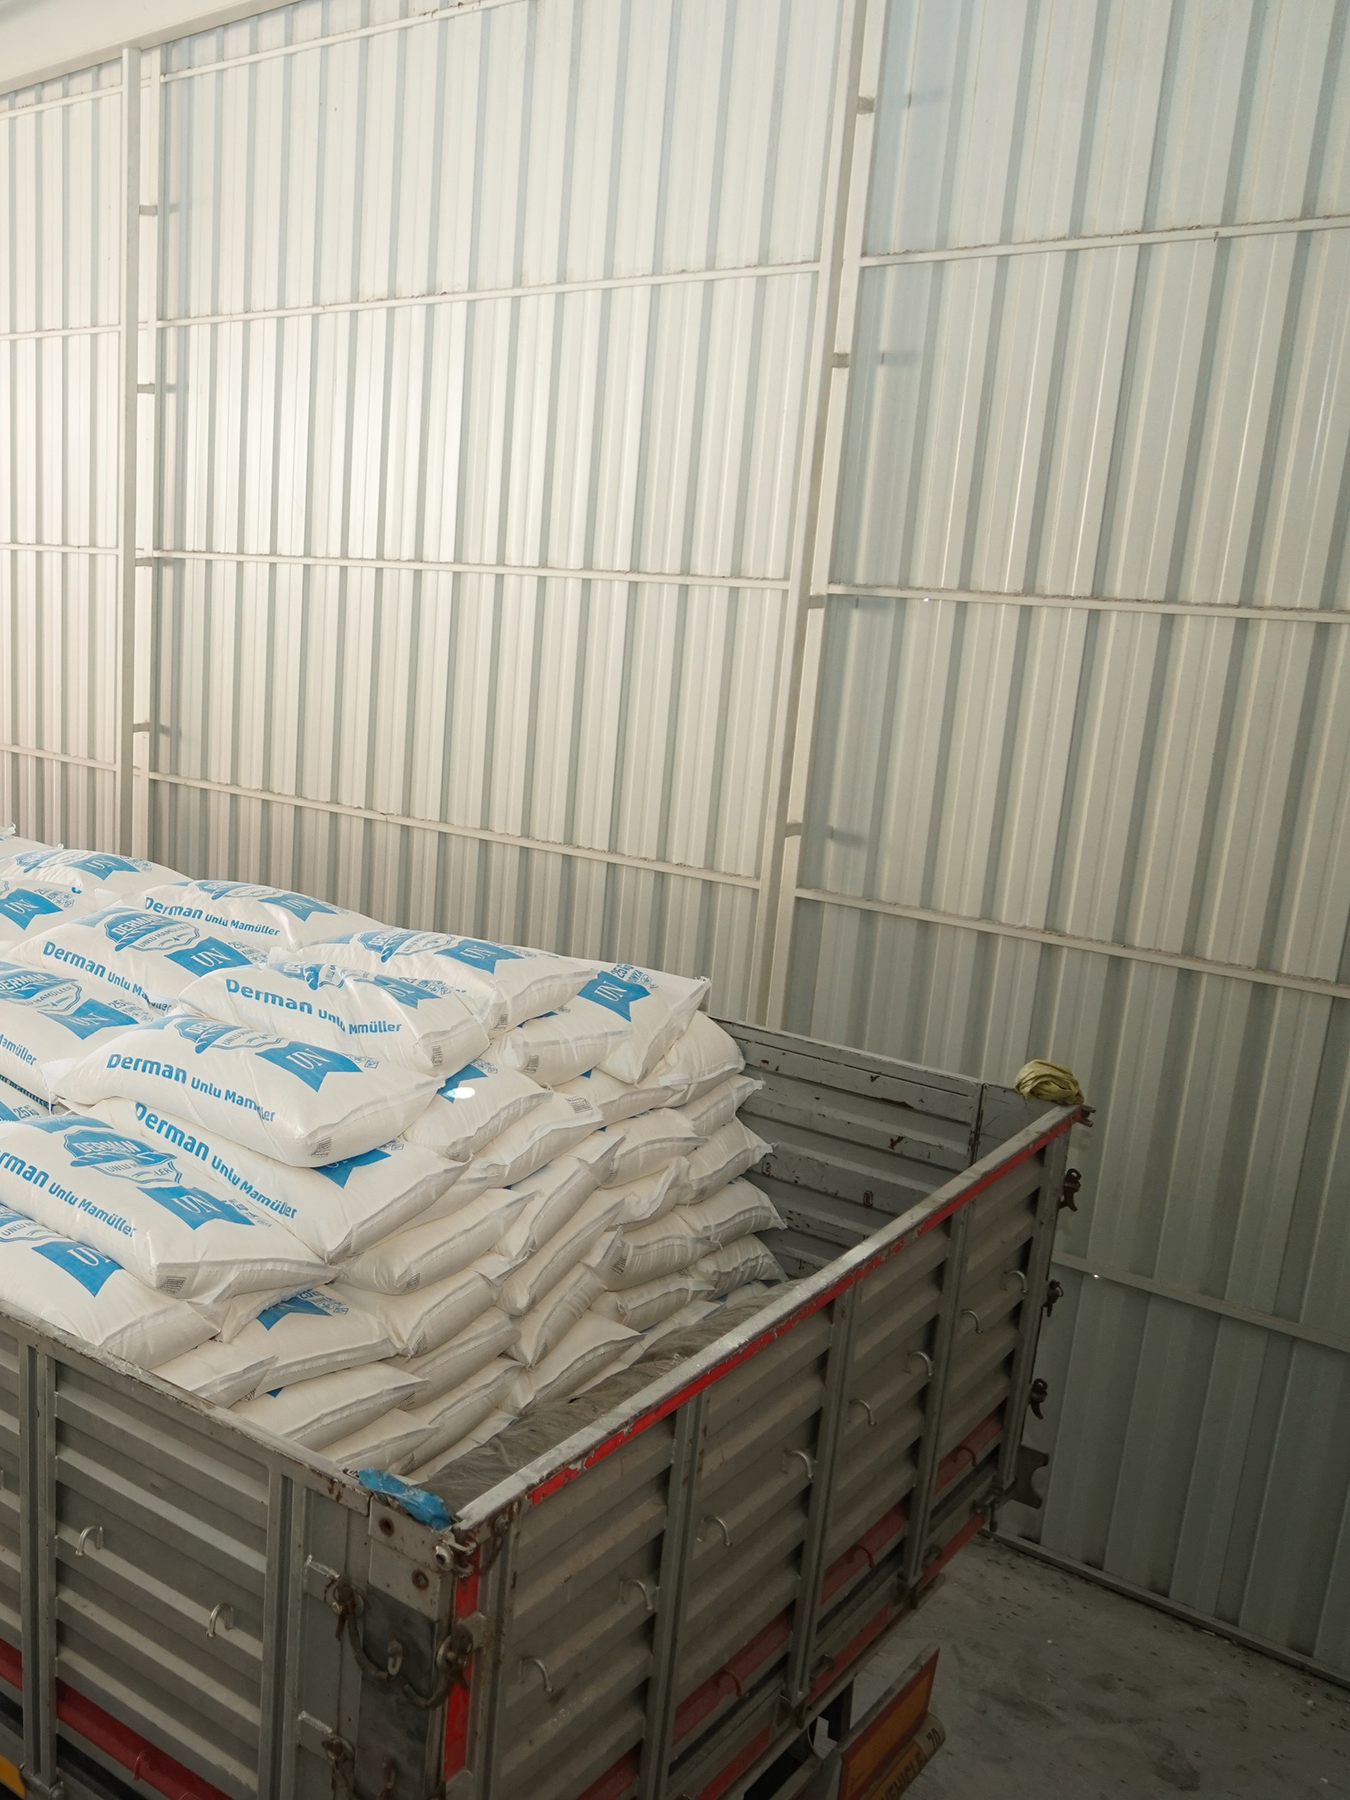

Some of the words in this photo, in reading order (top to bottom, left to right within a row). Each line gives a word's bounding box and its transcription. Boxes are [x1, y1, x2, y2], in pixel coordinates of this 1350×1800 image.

[2, 898, 40, 914] UN
[146, 895, 204, 921] Derman
[204, 912, 229, 928] Unlu
[230, 919, 282, 937] Mamüller
[113, 913, 166, 937] DERMAN
[189, 947, 233, 968] UN
[459, 943, 498, 961] UN
[42, 940, 107, 978] Derman
[107, 971, 132, 990] Unlu
[225, 978, 314, 1016] Derman
[594, 980, 629, 1002] UN
[67, 1010, 110, 1027] UN
[284, 1046, 331, 1071] UN
[106, 1052, 188, 1085] Derman
[190, 1076, 223, 1099] Unlu
[134, 1101, 211, 1162] Derman
[211, 1155, 242, 1186] Unlu
[239, 1181, 298, 1220] Mamüller
[48, 1182, 78, 1206] Unlu
[78, 1197, 138, 1239] Mamüller
[170, 1196, 223, 1215] UN
